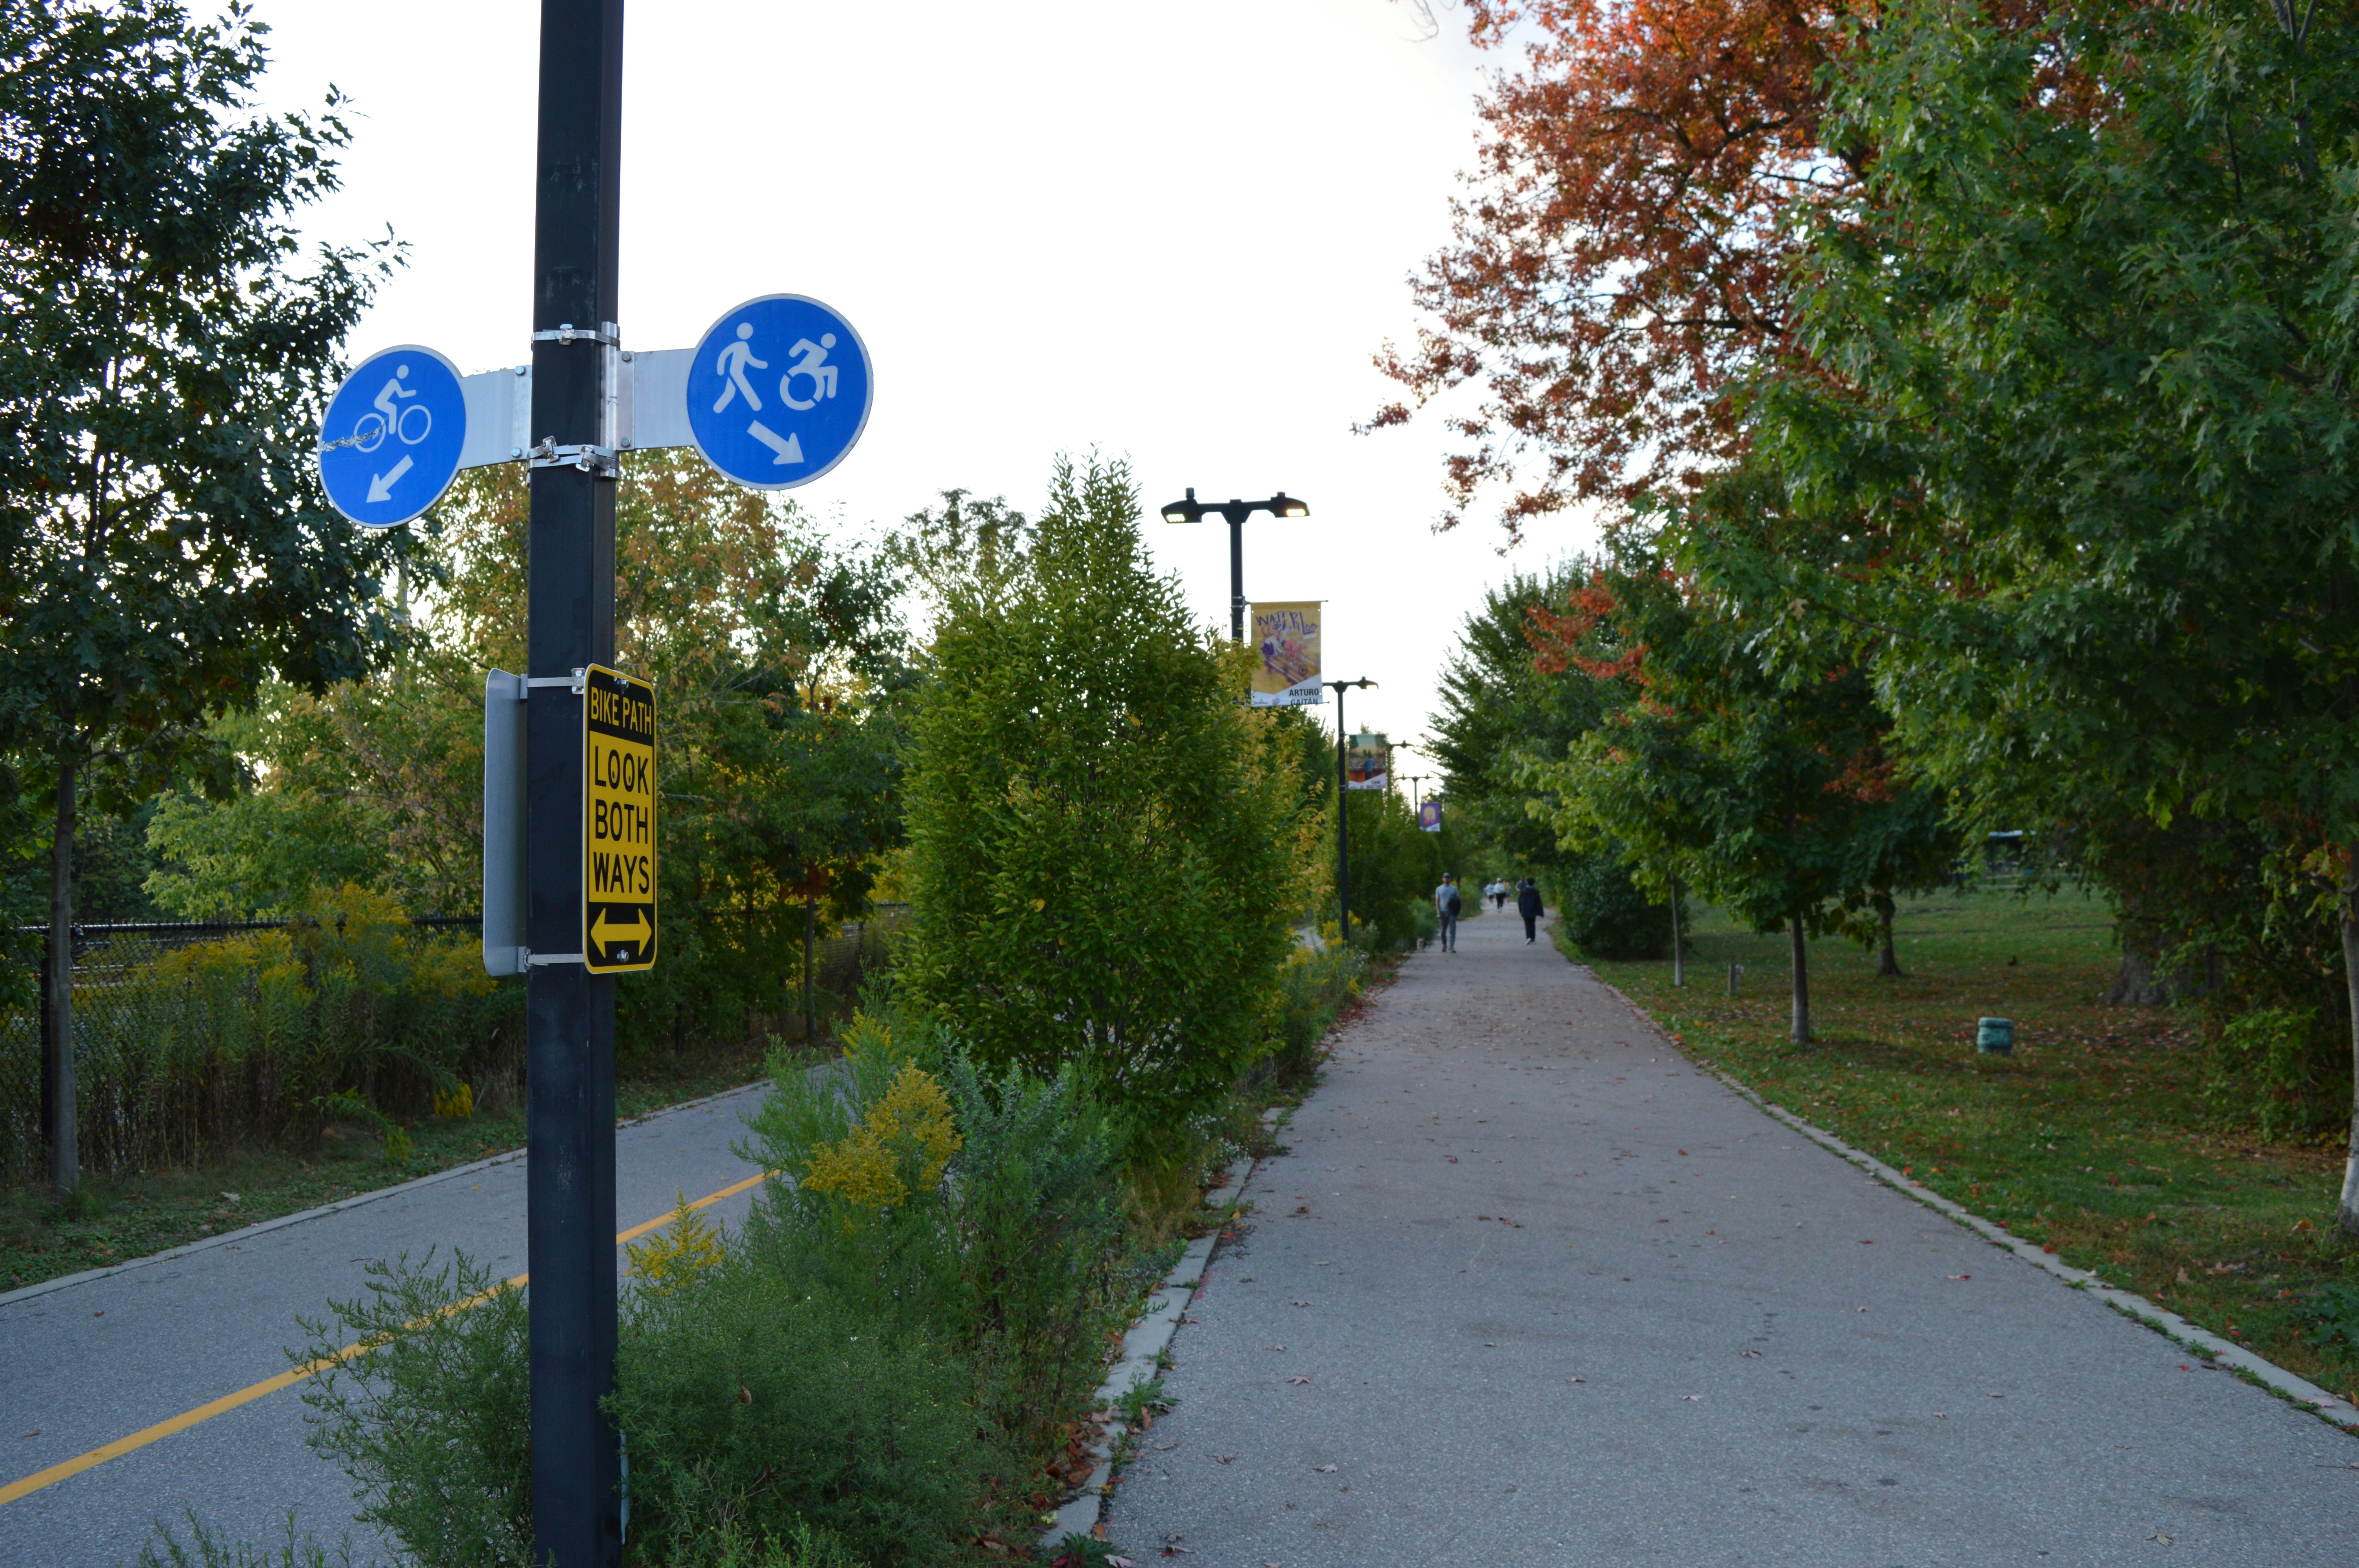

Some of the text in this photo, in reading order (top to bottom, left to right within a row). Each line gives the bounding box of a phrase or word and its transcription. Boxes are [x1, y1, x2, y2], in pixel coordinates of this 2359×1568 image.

[591, 686, 652, 735] BIKE PATH
[1289, 688, 1319, 697] ARTURO
[594, 745, 650, 796] LOOK
[594, 798, 649, 845] BOTH
[592, 851, 650, 895] WAYS
